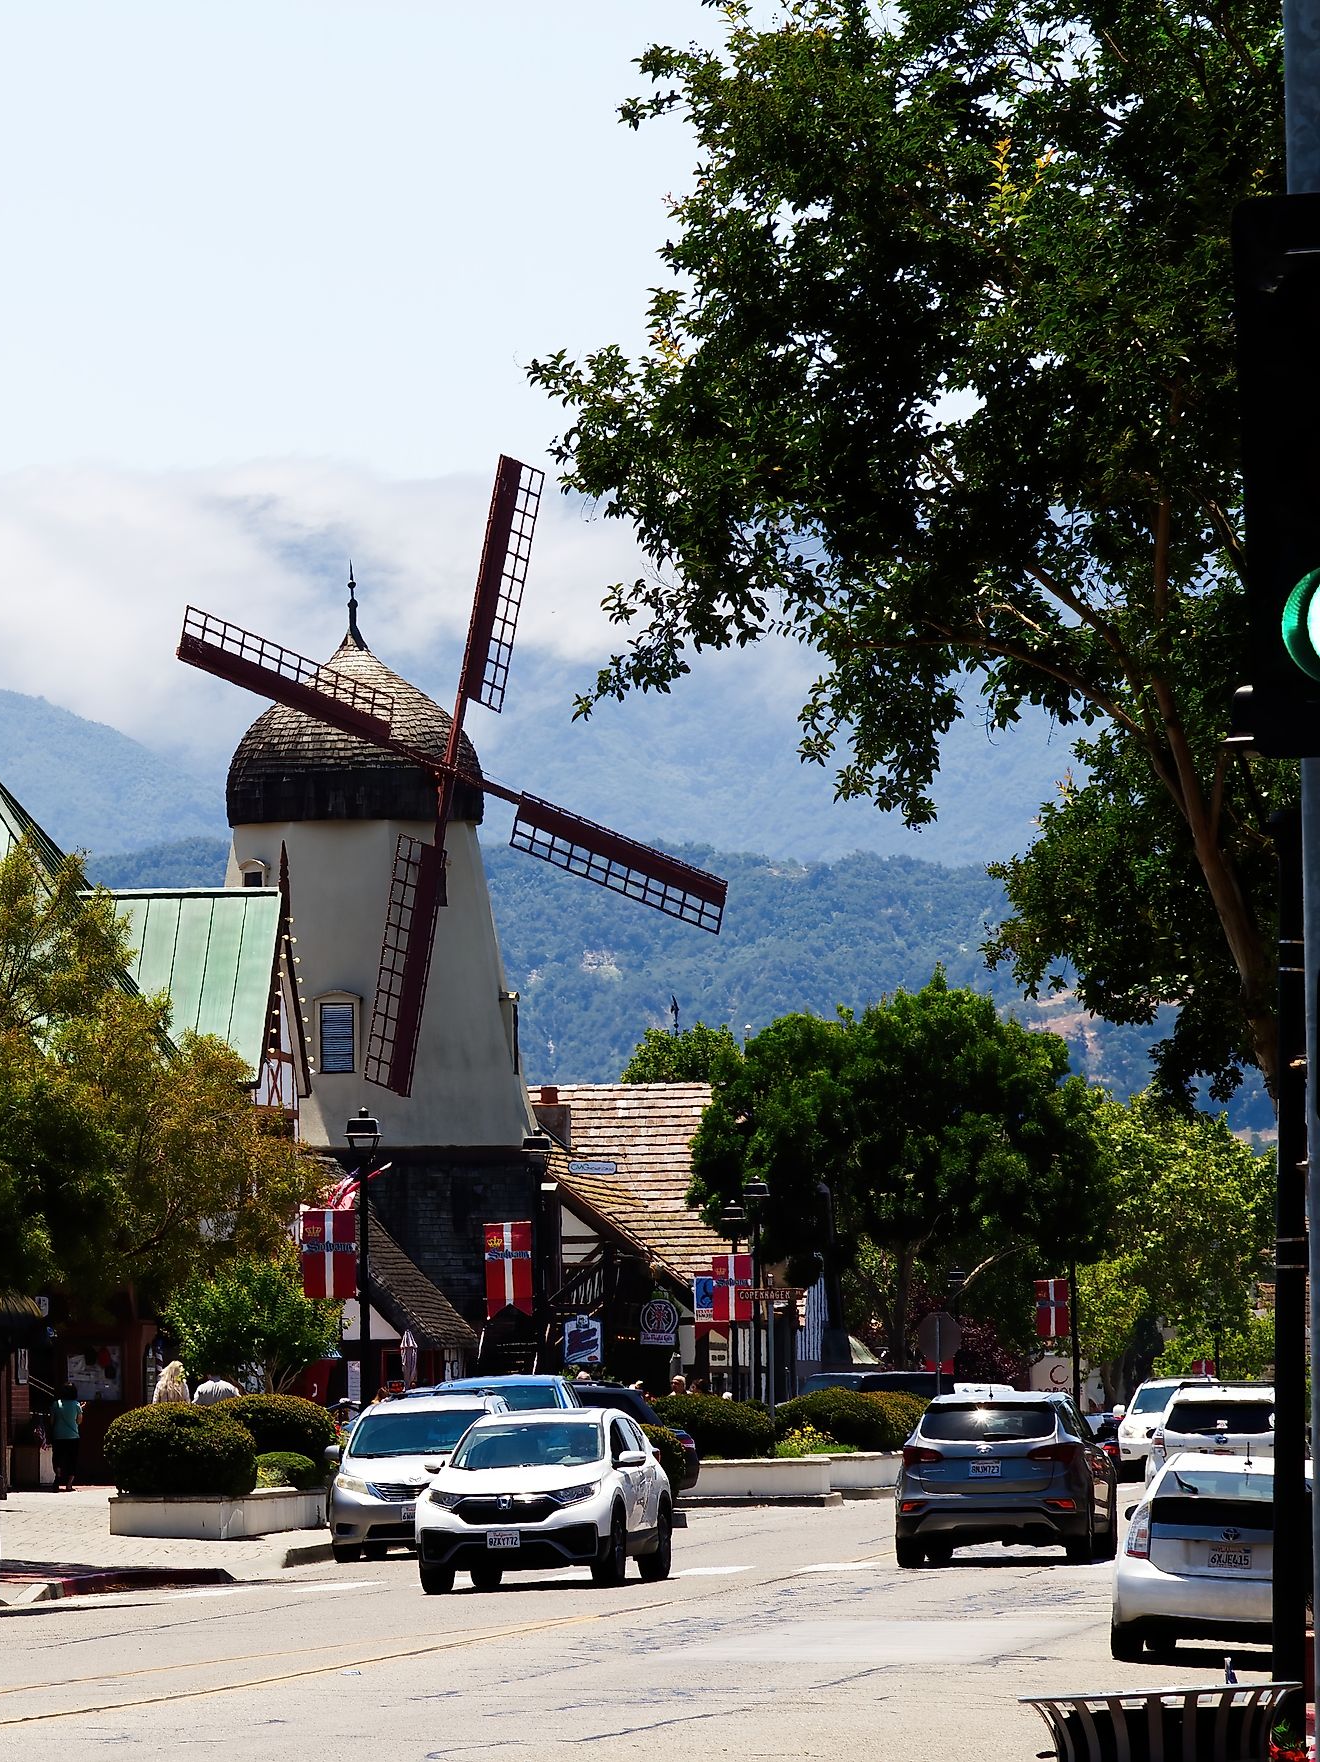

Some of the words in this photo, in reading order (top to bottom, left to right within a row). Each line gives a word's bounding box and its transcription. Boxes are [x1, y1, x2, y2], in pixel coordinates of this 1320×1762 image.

[306, 1239, 353, 1254] Solvang
[487, 1247, 530, 1262] Solvang
[739, 1290, 790, 1300] COPENHAGEN
[1211, 1553, 1249, 1566] 6XJE415
